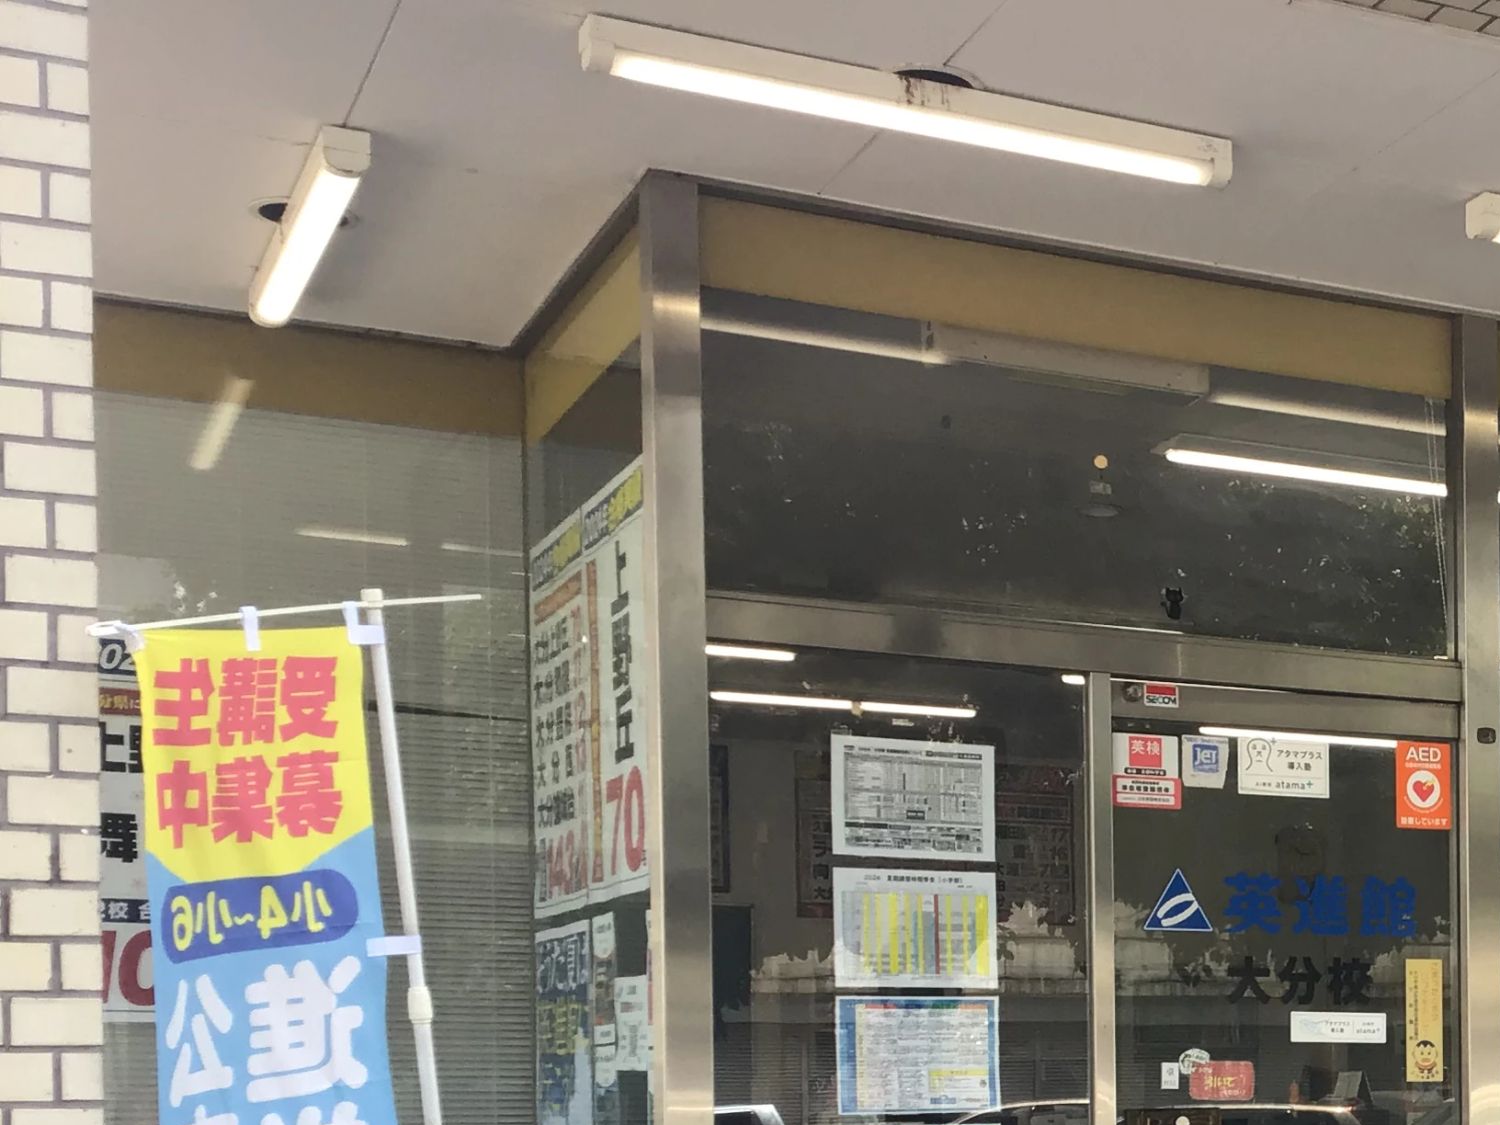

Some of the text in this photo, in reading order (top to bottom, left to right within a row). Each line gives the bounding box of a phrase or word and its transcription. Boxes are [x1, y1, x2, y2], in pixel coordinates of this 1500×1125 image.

[1145, 695, 1177, 705] SECOM
[1406, 747, 1442, 762] AED
[1223, 872, 1417, 939] 英進館
[1227, 956, 1375, 1005] 大分校
